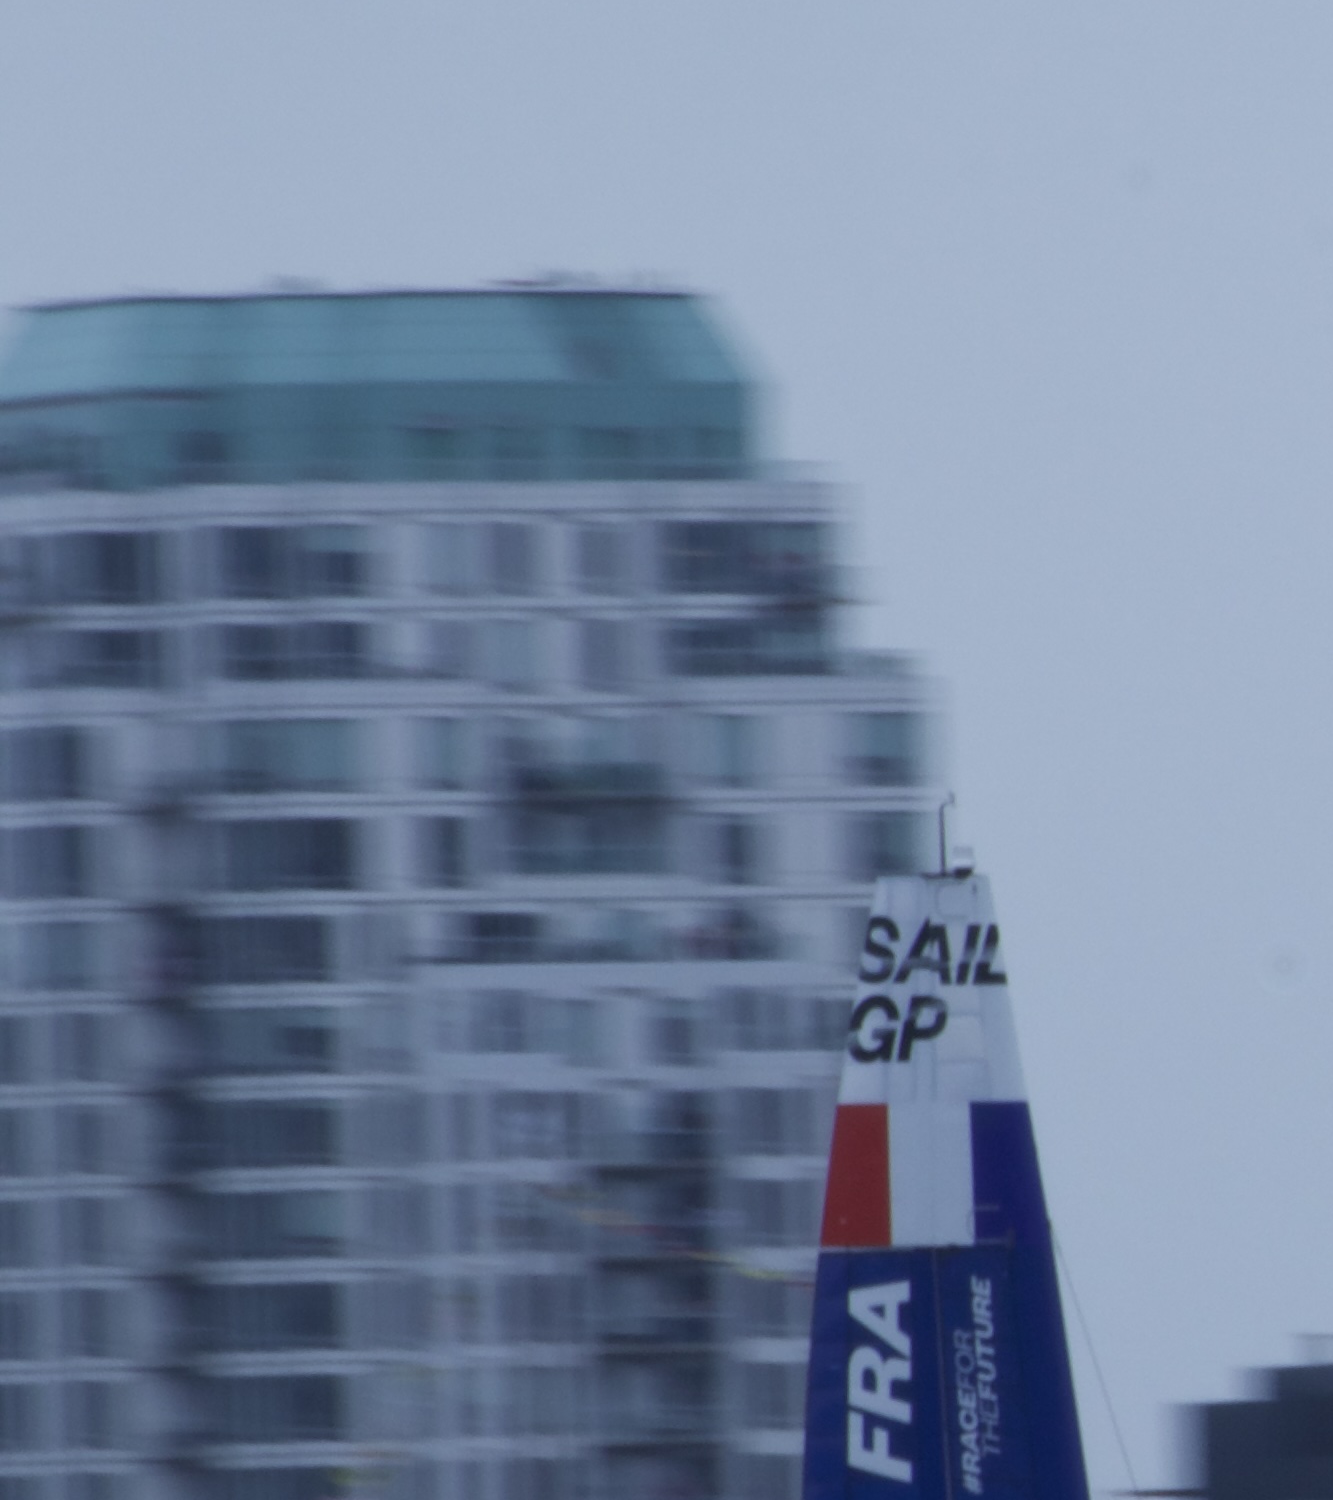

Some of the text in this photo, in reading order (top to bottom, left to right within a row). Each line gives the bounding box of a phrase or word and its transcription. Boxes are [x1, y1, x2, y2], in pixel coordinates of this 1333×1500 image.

[858, 916, 1007, 985] SAIL
[849, 994, 948, 1063] GP
[848, 1280, 912, 1484] FRA
